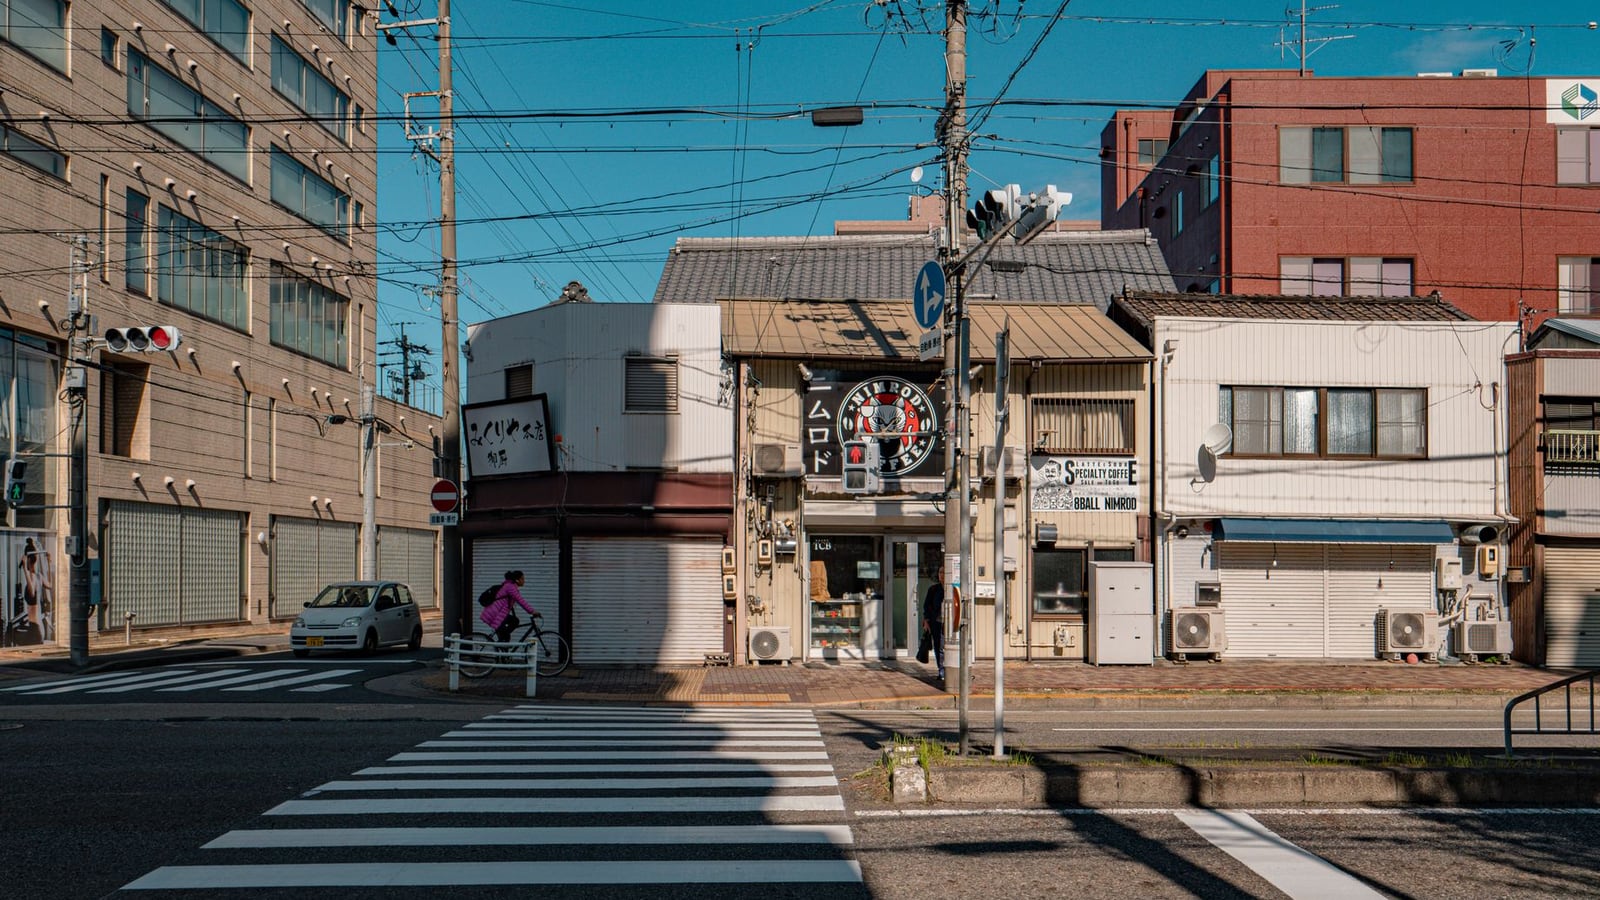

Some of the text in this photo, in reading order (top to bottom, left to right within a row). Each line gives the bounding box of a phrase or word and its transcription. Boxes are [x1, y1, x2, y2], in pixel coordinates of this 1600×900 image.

[851, 381, 922, 407] NIMROD
[808, 377, 832, 473] ニムロド
[1065, 460, 1137, 486] SPECIALTY COFFEE
[1074, 497, 1137, 511] 8BALL NIMROD
[813, 541, 832, 551] TCB
